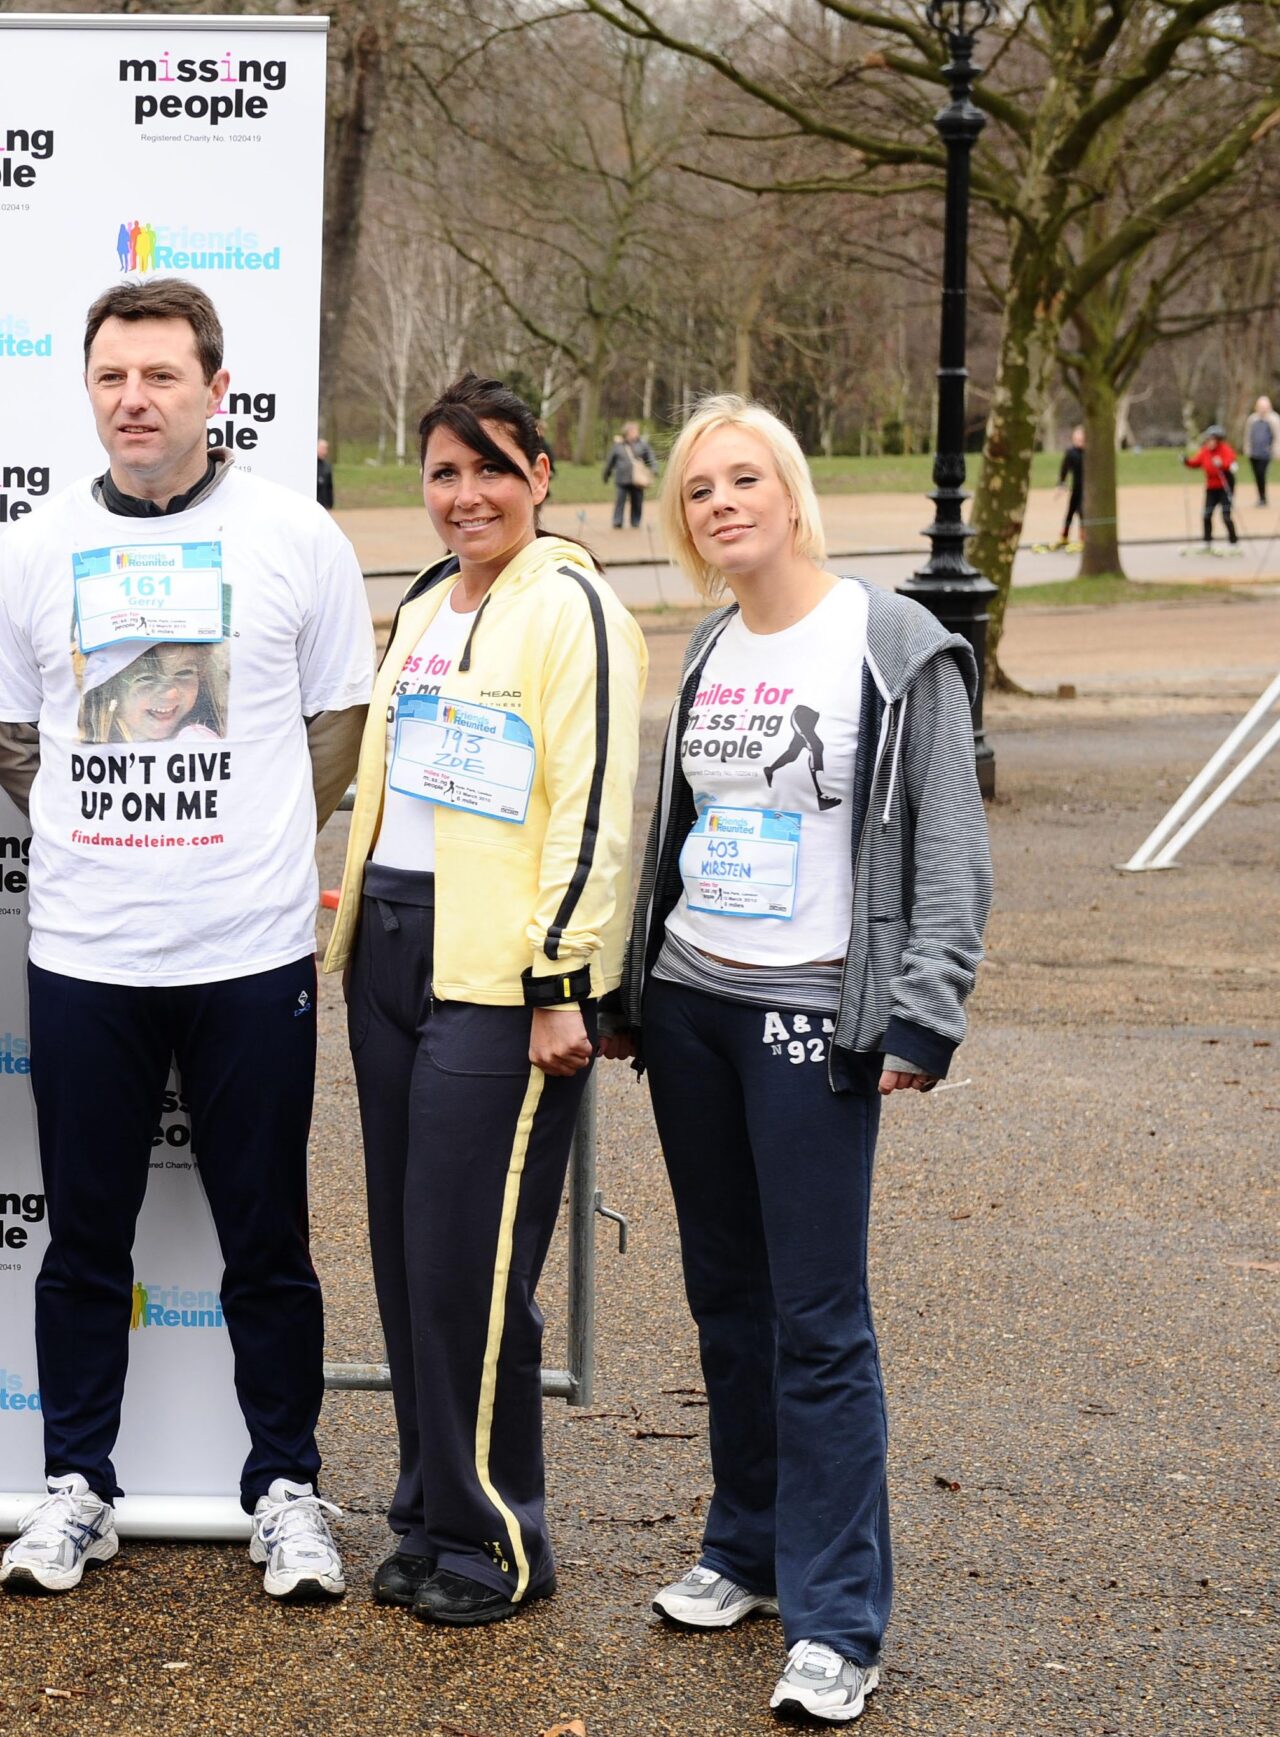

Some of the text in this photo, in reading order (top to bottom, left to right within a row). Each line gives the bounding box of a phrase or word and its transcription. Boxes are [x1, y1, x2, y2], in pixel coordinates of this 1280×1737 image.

[119, 51, 287, 91] missing
[135, 89, 268, 125] people
[141, 134, 262, 143] Registered Charity No. 1020419
[156, 226, 259, 250] Friends
[155, 246, 280, 270] Reunited
[129, 557, 175, 568] Reunited
[119, 575, 173, 597] 161
[128, 597, 165, 608] Gerry
[480, 690, 522, 698] HEAD
[693, 682, 794, 707] miles for
[454, 715, 497, 734] Reunited
[441, 728, 485, 753] 193
[71, 751, 231, 785] DON'T GIVE
[433, 753, 485, 774] ZOE
[81, 789, 218, 822] UP ON ME
[72, 830, 224, 848] findmadeleine.com
[717, 822, 755, 835] Reunited
[707, 839, 740, 858] 403
[701, 861, 752, 878] KIRSTEN
[787, 1038, 826, 1064] 92
[165, 1160, 192, 1170] Charity
[146, 1285, 220, 1307] Frien
[146, 1303, 224, 1327] Reuni
